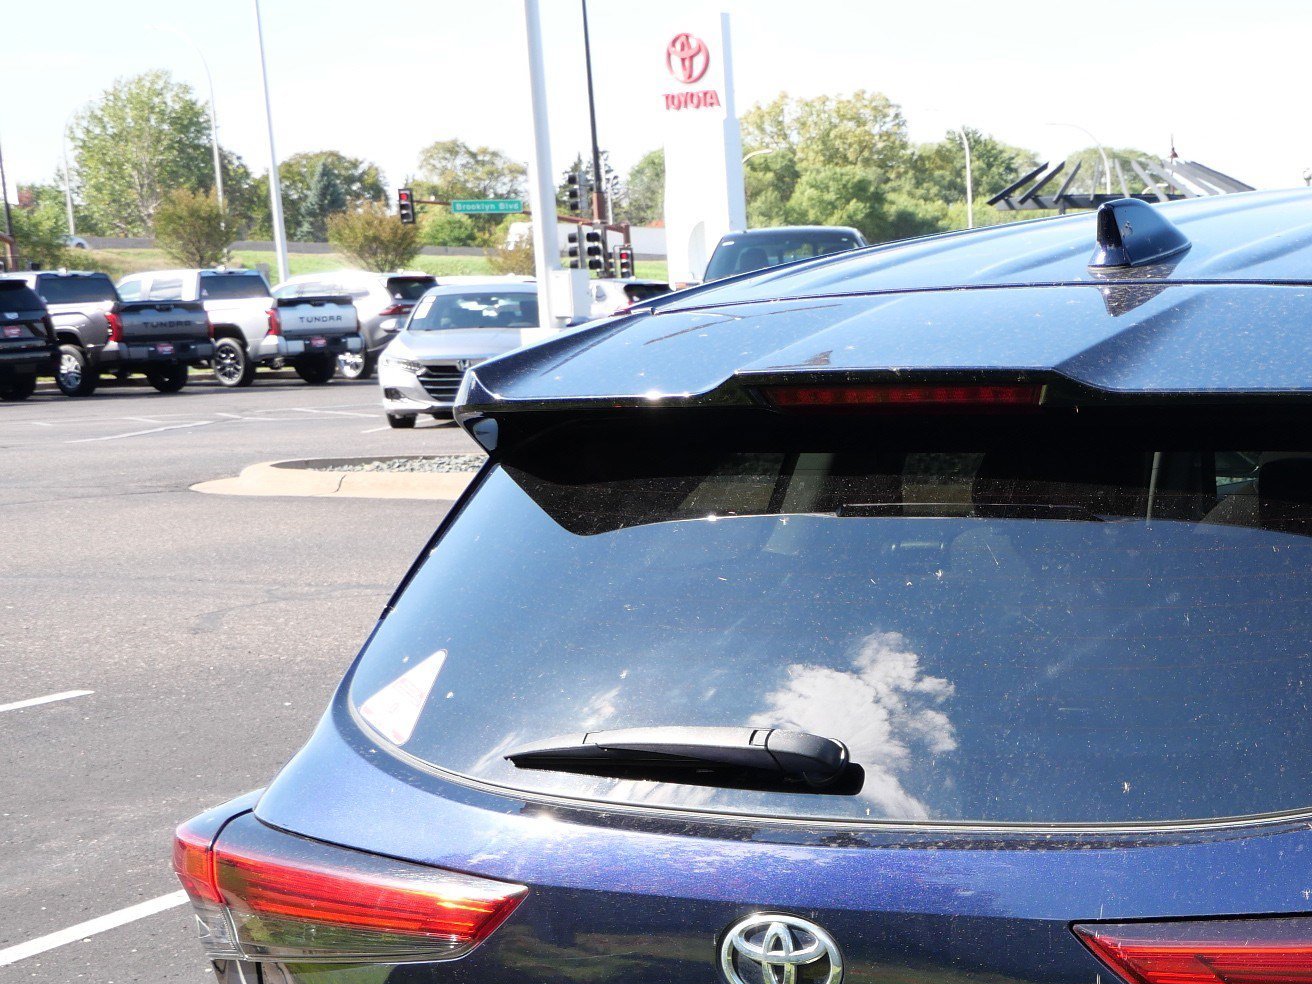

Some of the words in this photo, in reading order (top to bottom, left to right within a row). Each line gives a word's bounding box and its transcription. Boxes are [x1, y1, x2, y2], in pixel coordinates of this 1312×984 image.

[662, 90, 721, 110] TOYOTA
[455, 202, 496, 212] Brooklyn
[498, 202, 520, 210] Blvd
[143, 320, 192, 328] TUNDRA
[299, 315, 343, 324] TUNDRA
